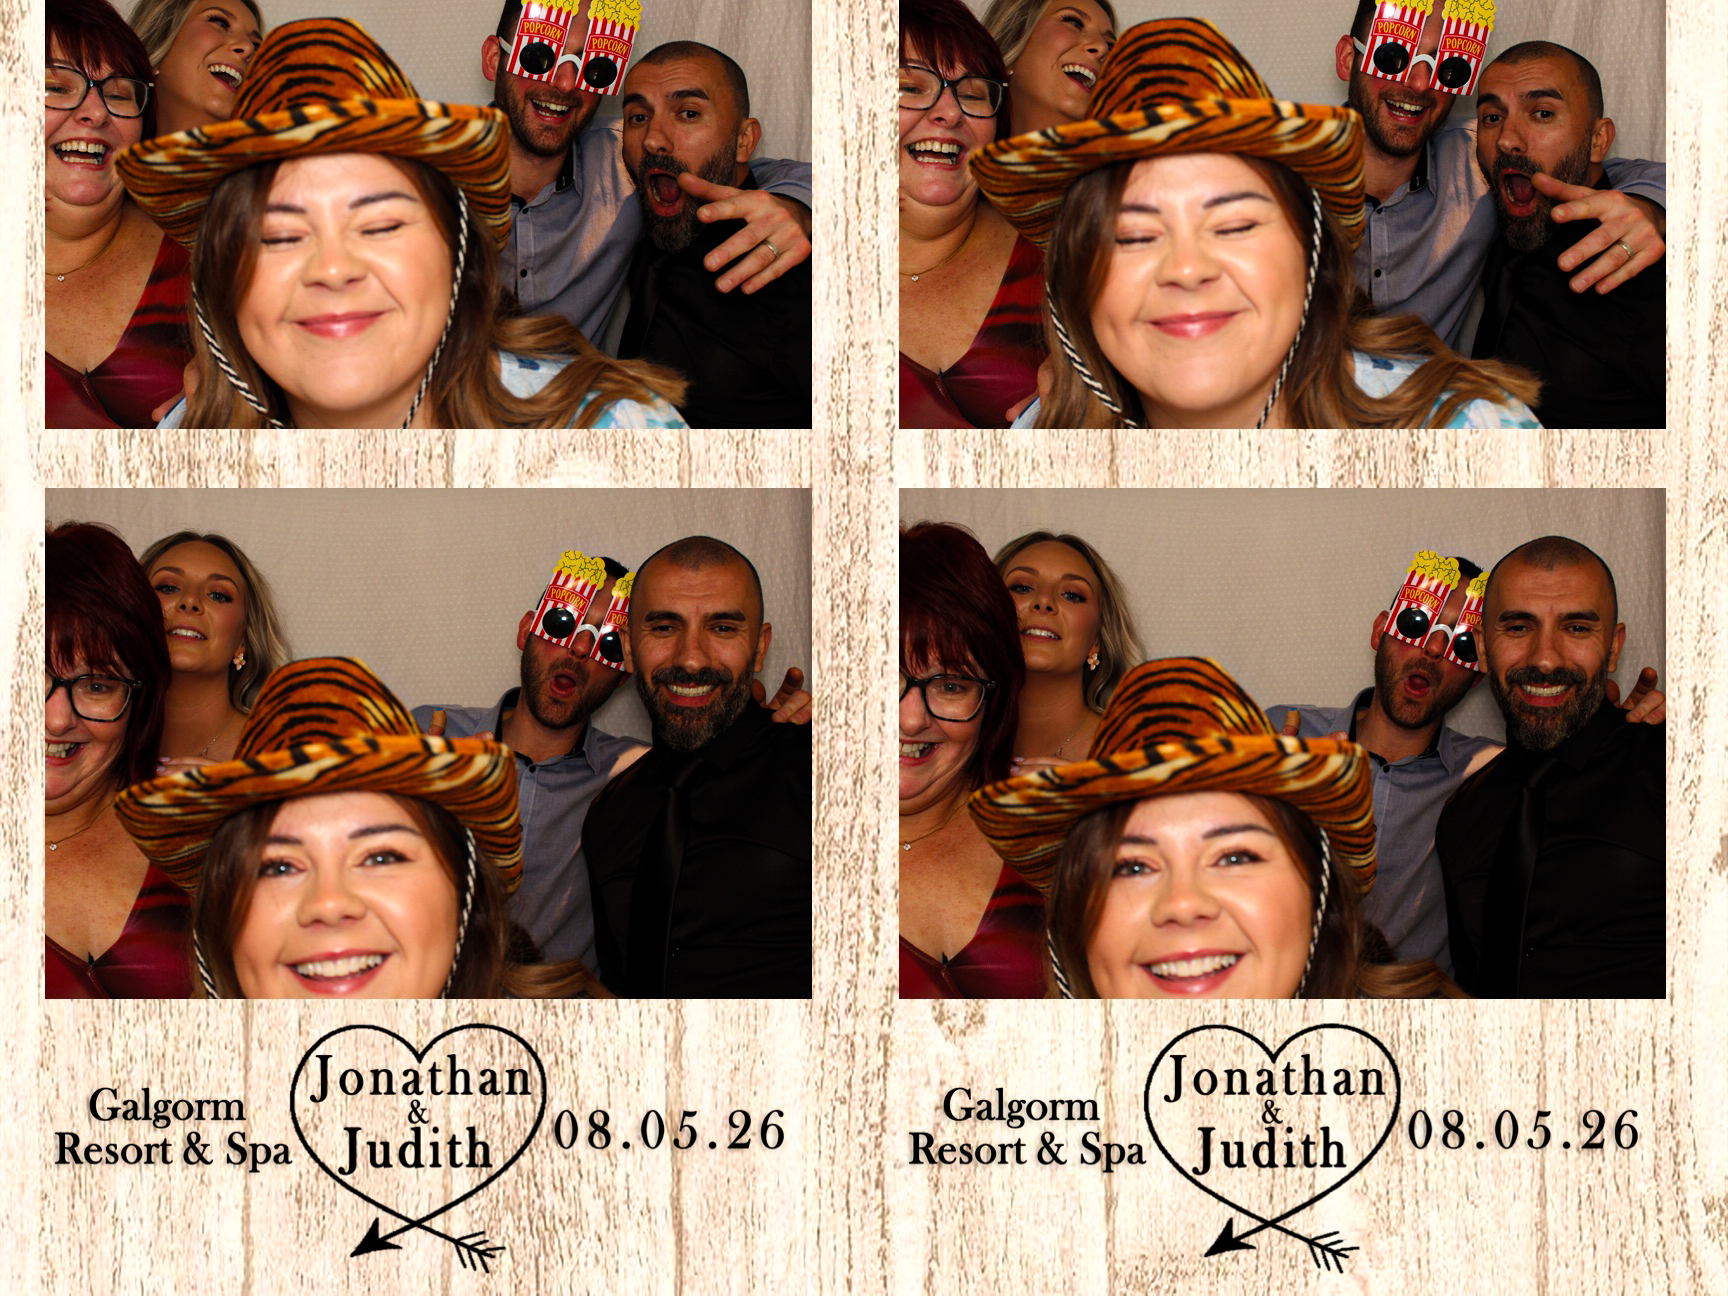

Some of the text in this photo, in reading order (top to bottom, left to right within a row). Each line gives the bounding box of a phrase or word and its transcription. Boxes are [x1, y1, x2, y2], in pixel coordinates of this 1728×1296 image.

[523, 21, 563, 40] POPCORN
[1377, 21, 1417, 40] POPCORN
[591, 38, 629, 55] POPCORN
[1445, 38, 1483, 55] POPCORN
[549, 586, 586, 608] POPCORN
[1403, 586, 1440, 608] POPCORN
